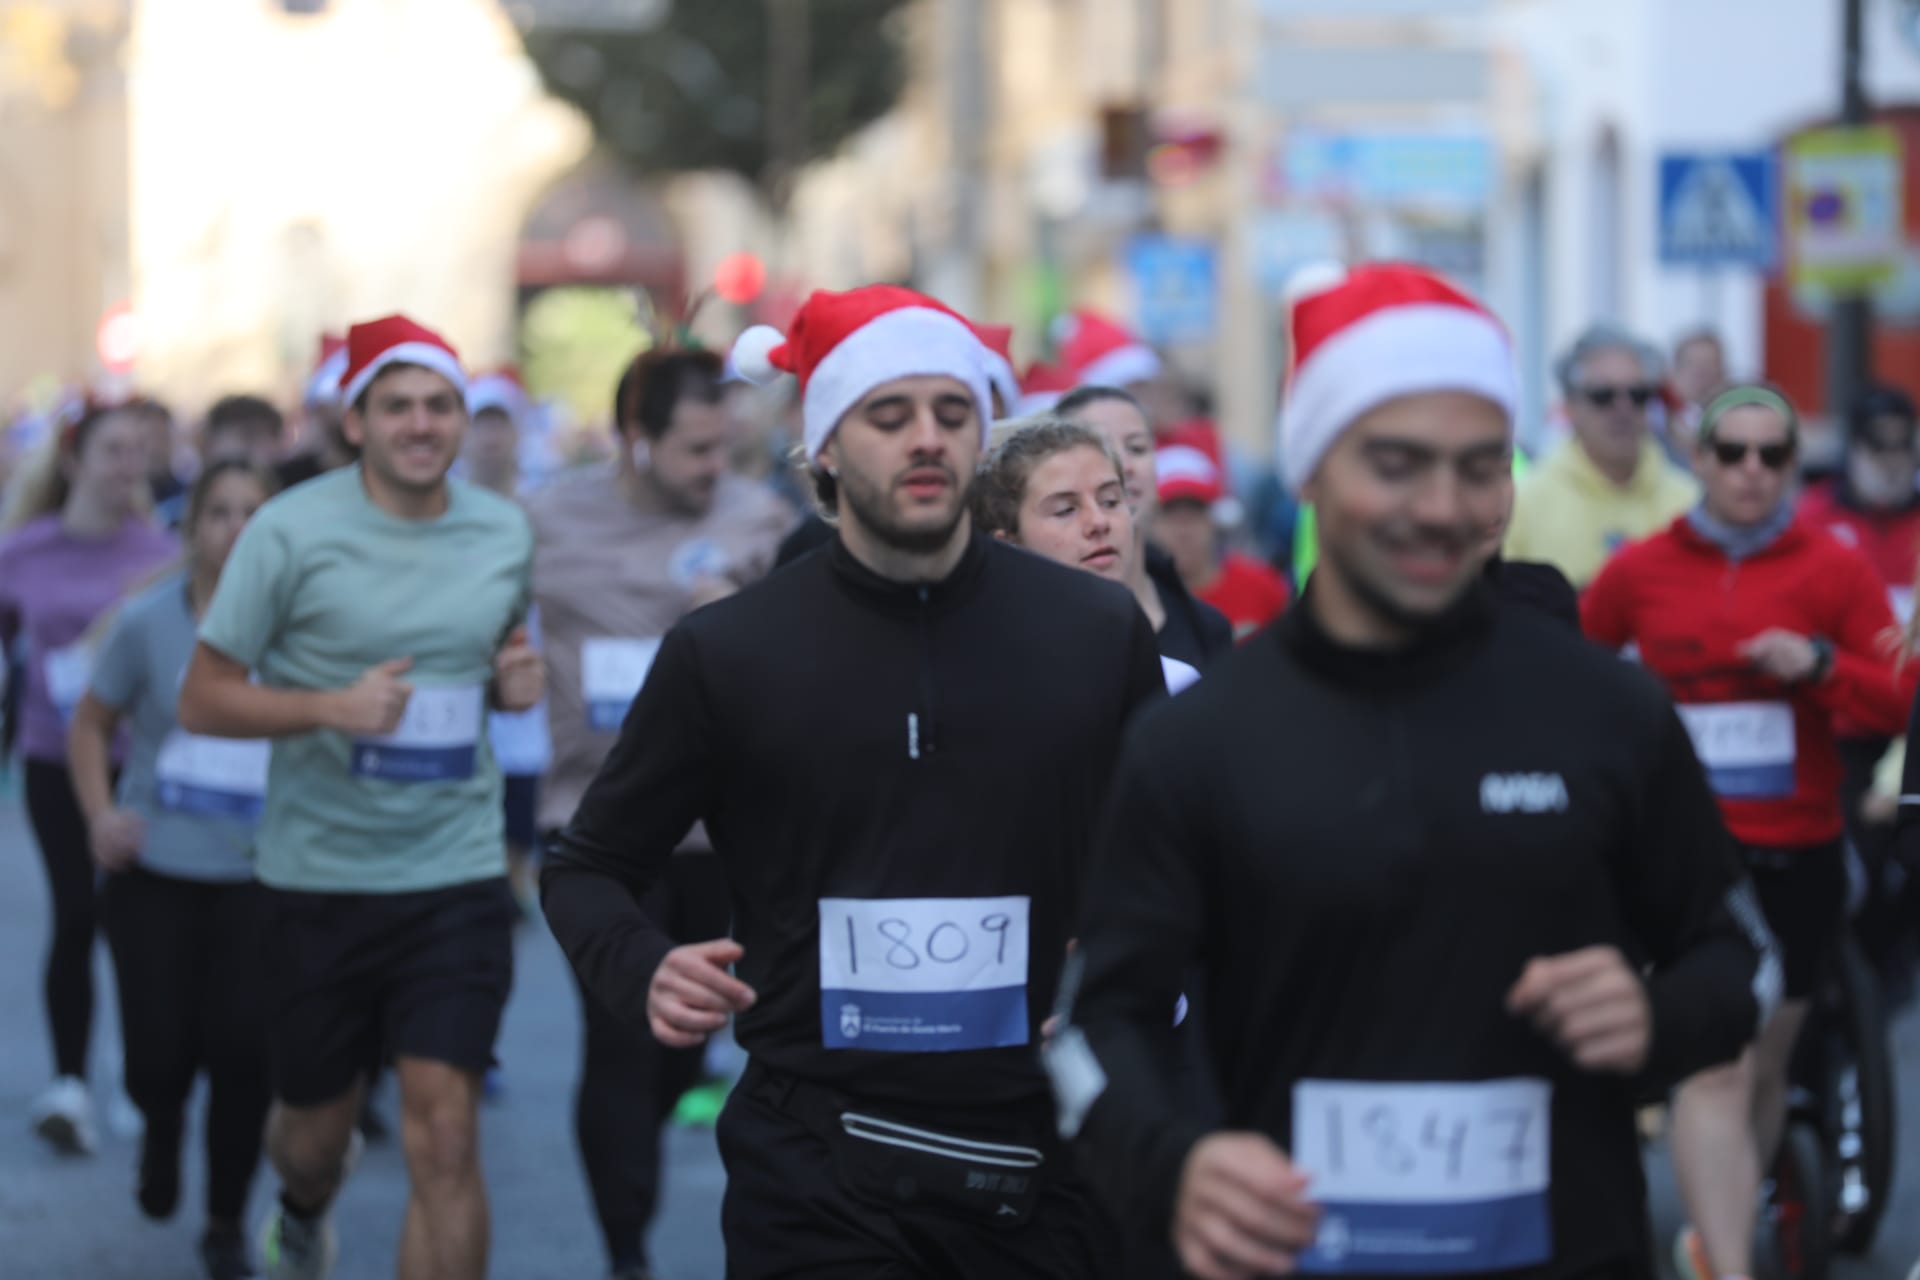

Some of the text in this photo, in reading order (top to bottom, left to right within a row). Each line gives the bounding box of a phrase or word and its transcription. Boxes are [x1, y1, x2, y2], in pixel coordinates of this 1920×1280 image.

[1480, 771, 1568, 814] NASA
[847, 913, 1011, 975] 1809
[1323, 1099, 1536, 1183] 1847
